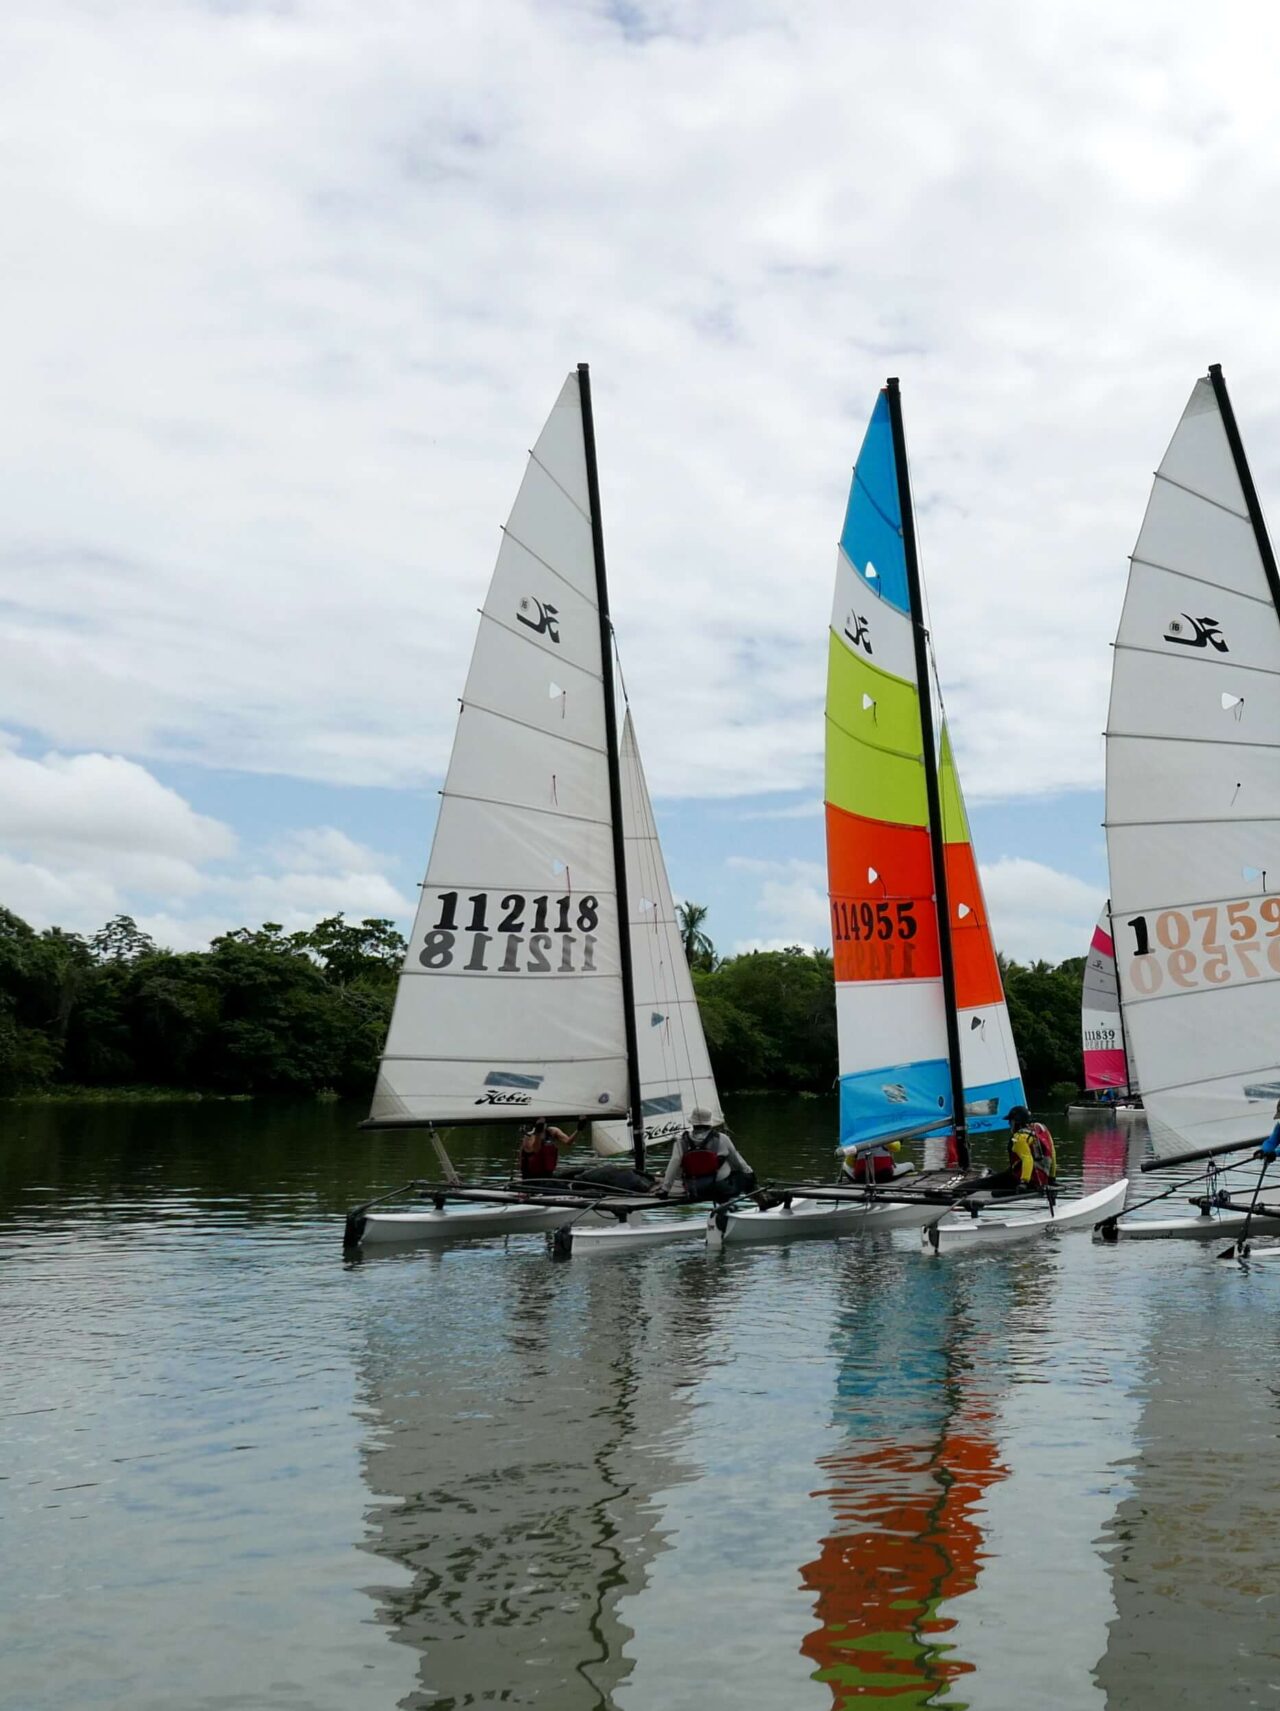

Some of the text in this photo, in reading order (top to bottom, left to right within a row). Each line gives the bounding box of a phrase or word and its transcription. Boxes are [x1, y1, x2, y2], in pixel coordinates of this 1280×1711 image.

[1171, 623, 1180, 631] 16
[433, 891, 599, 933] 112118
[833, 901, 917, 941] 114955
[1084, 1029, 1116, 1041] 111839
[475, 1089, 532, 1105] Hobie
[645, 1121, 688, 1140] Hobie
